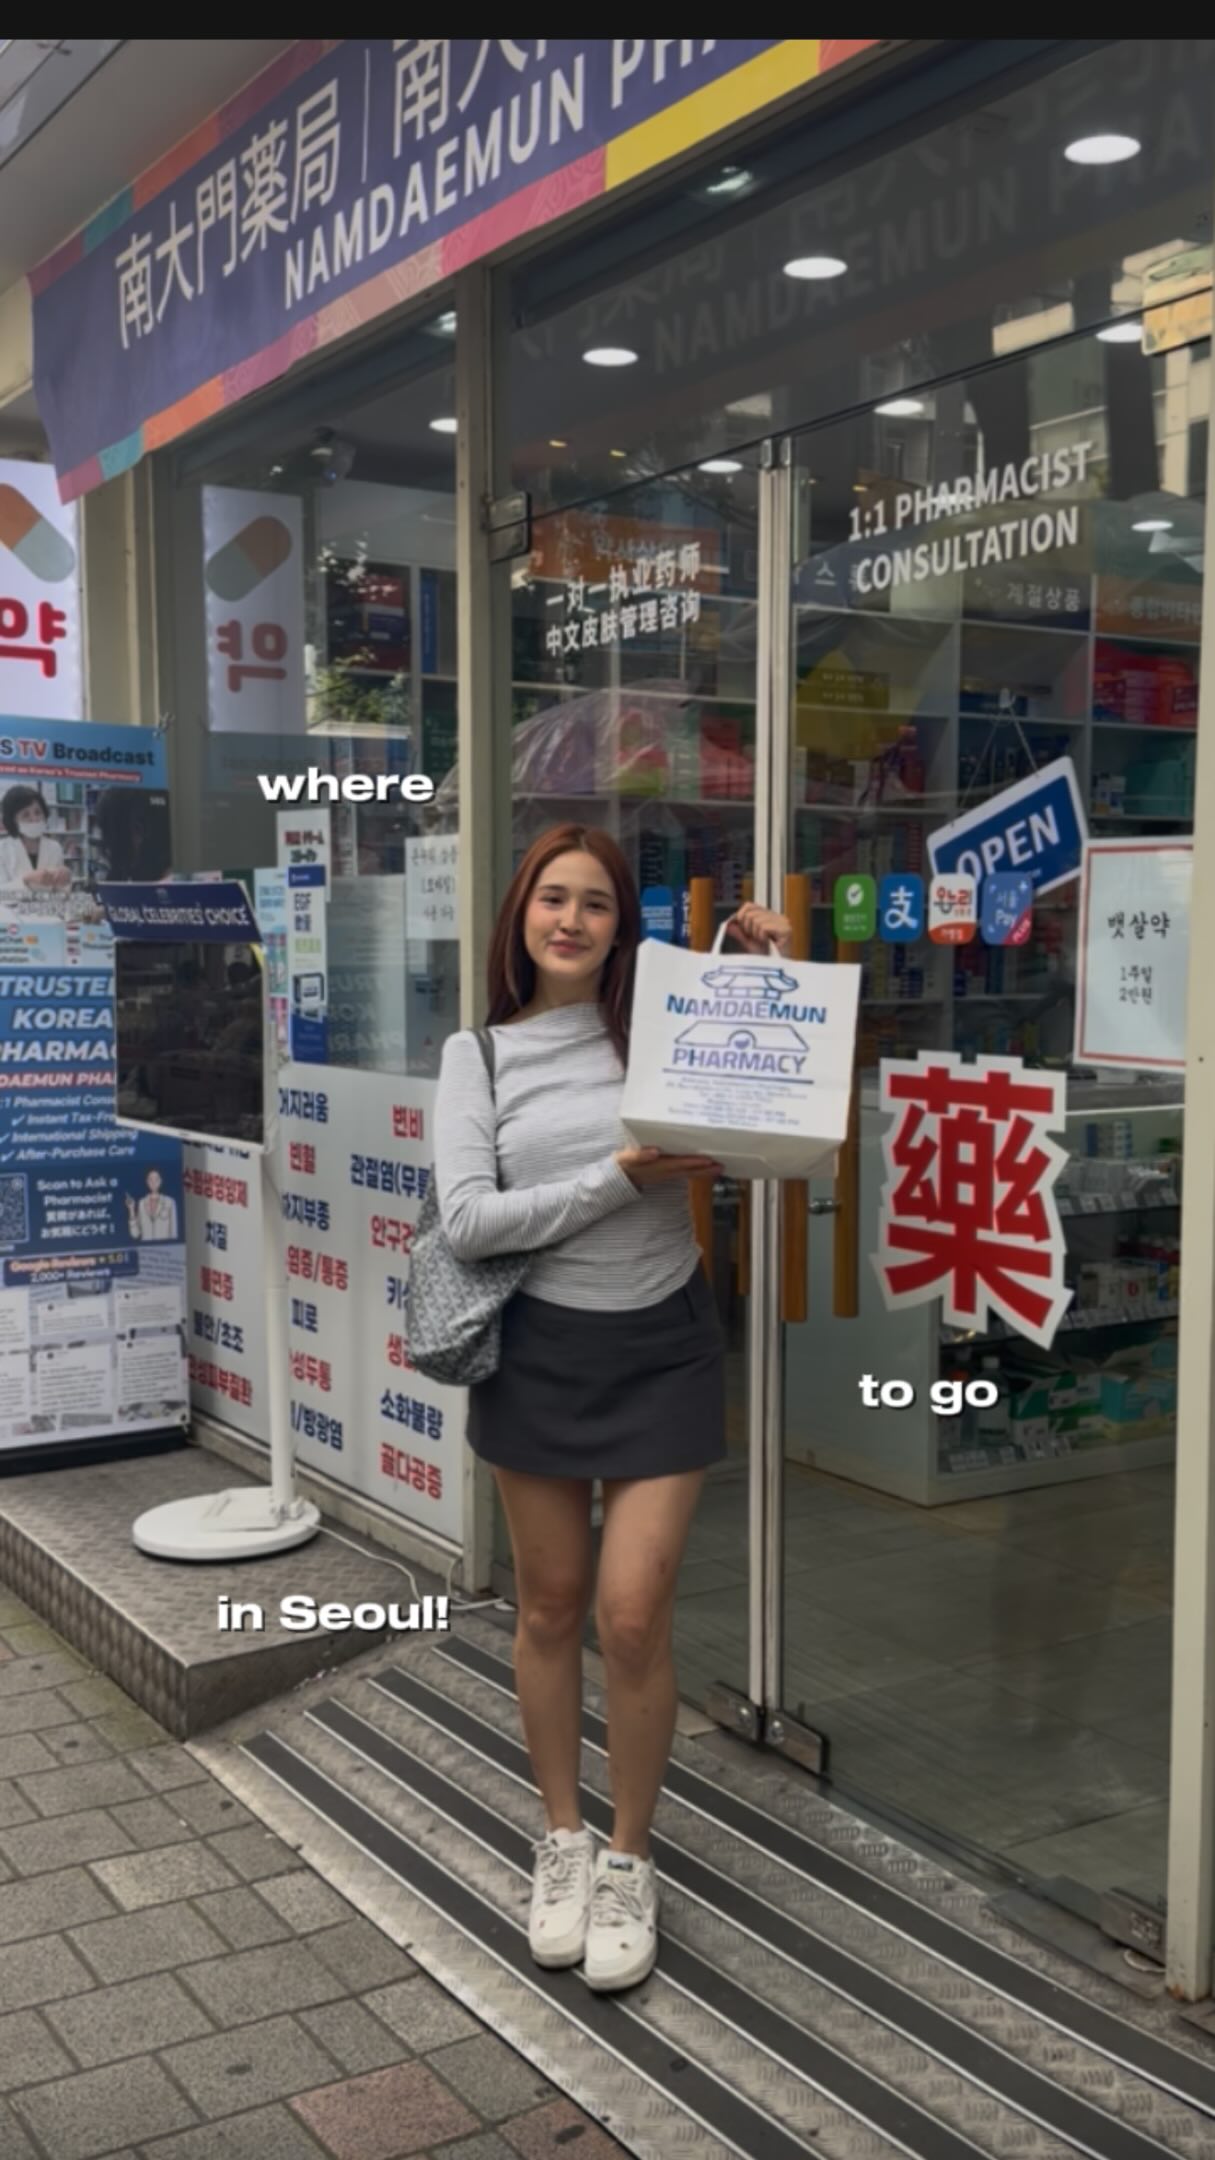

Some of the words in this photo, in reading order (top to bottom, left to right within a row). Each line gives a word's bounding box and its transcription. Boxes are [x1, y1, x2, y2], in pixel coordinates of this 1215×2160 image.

[284, 52, 585, 309] NAMDAEMUN
[848, 501, 886, 543] 1:1
[895, 440, 1093, 531] PHARMACIST
[857, 505, 1080, 594] CONSULTATION
[545, 541, 701, 614] 一对一执业药师
[0, 598, 67, 679] 약
[545, 588, 701, 656] 中文皮肤管理咨询
[18, 739, 47, 758] TV
[53, 741, 155, 766] Broadcast
[957, 805, 1061, 886] OPEN
[204, 904, 249, 926] CHOICE
[665, 994, 827, 1025] NAMDAEMUN
[0, 1041, 116, 1062] HARMA
[672, 1047, 807, 1075] PHARMACY
[11, 1129, 87, 1144] International
[89, 1127, 138, 1143] Shipping
[392, 1104, 425, 1141] 변비
[109, 1144, 136, 1157] Care
[37, 1180, 69, 1191] Scan
[70, 1179, 83, 1190] to
[85, 1177, 107, 1189] Ask
[44, 1192, 113, 1206] Pharmacist
[884, 1065, 1055, 1330] 藥
[380, 1388, 444, 1442] 소화불량
[380, 1441, 443, 1501] 골다공증
